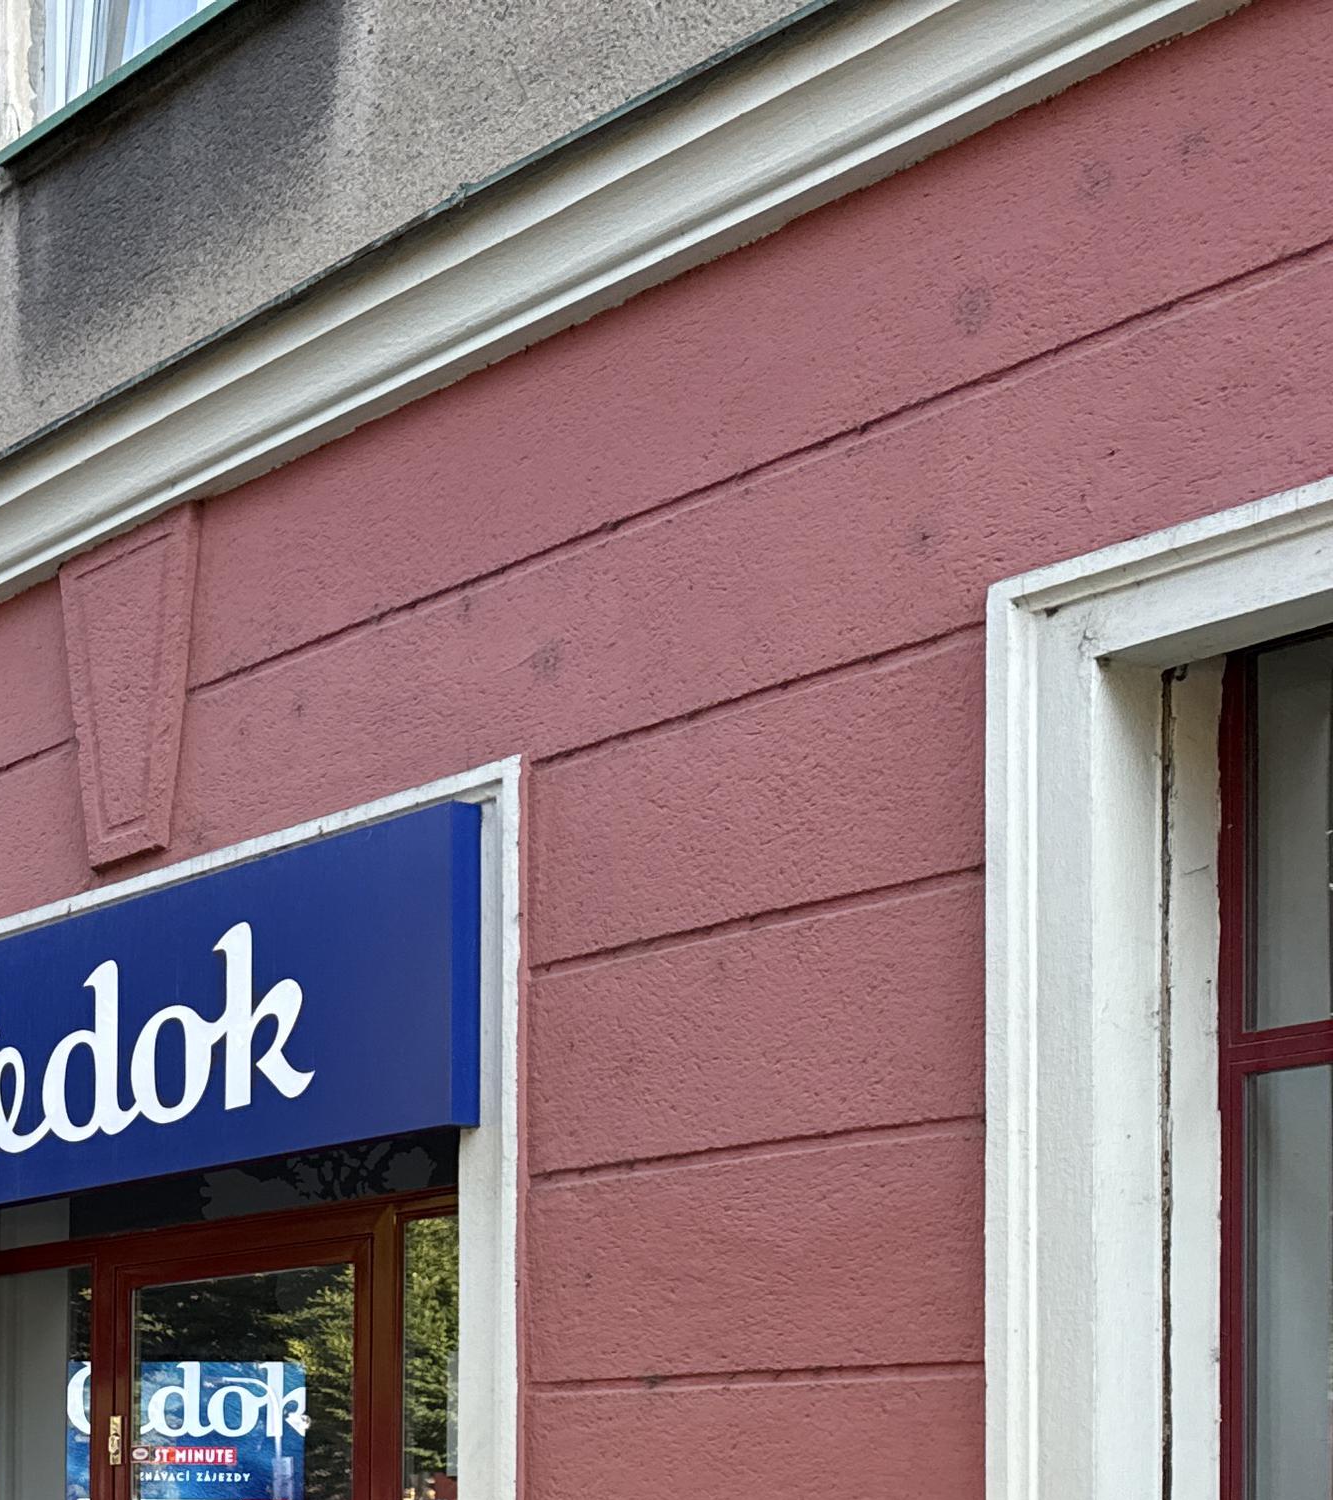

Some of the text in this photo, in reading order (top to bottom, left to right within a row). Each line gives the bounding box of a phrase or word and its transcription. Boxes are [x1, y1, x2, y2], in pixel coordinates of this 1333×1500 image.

[67, 1361, 307, 1437] dok
[174, 1448, 234, 1463] MINUTE
[196, 1469, 251, 1482] ZÁJEZDY
